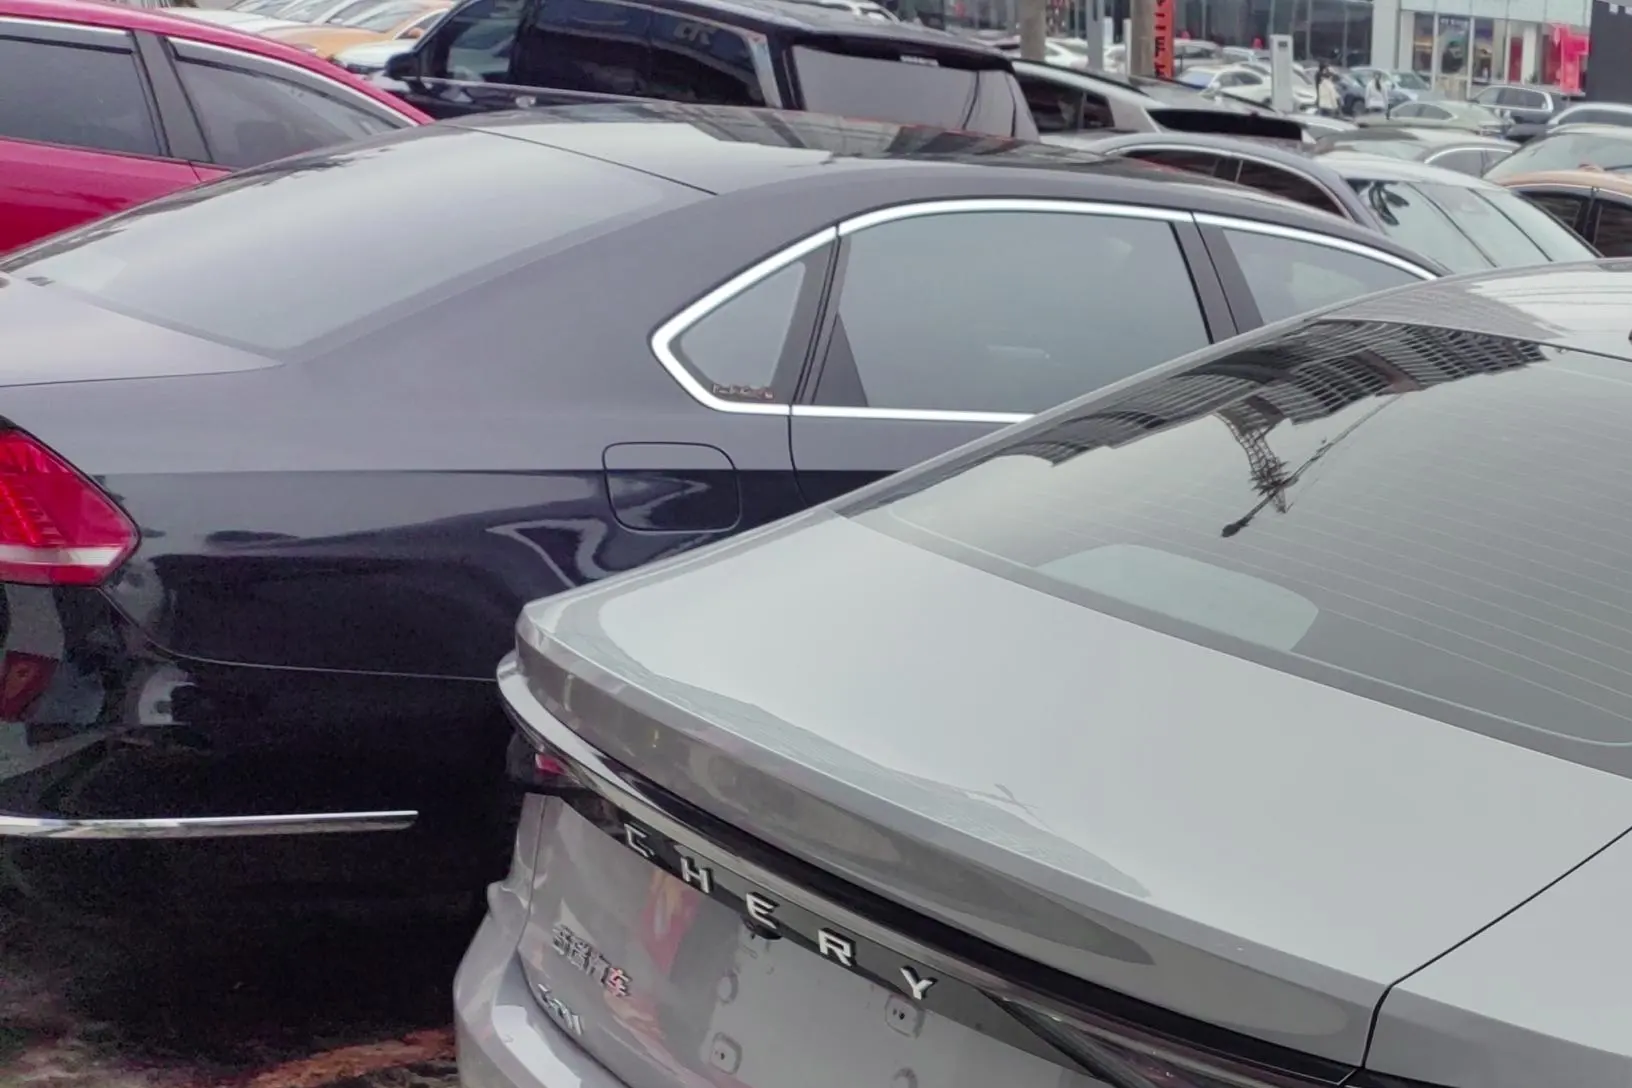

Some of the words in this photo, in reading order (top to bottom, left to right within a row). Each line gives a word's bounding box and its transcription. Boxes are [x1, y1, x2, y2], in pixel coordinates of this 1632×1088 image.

[552, 923, 633, 997] 奇瑞汽车
[623, 822, 938, 1001] CHERY
